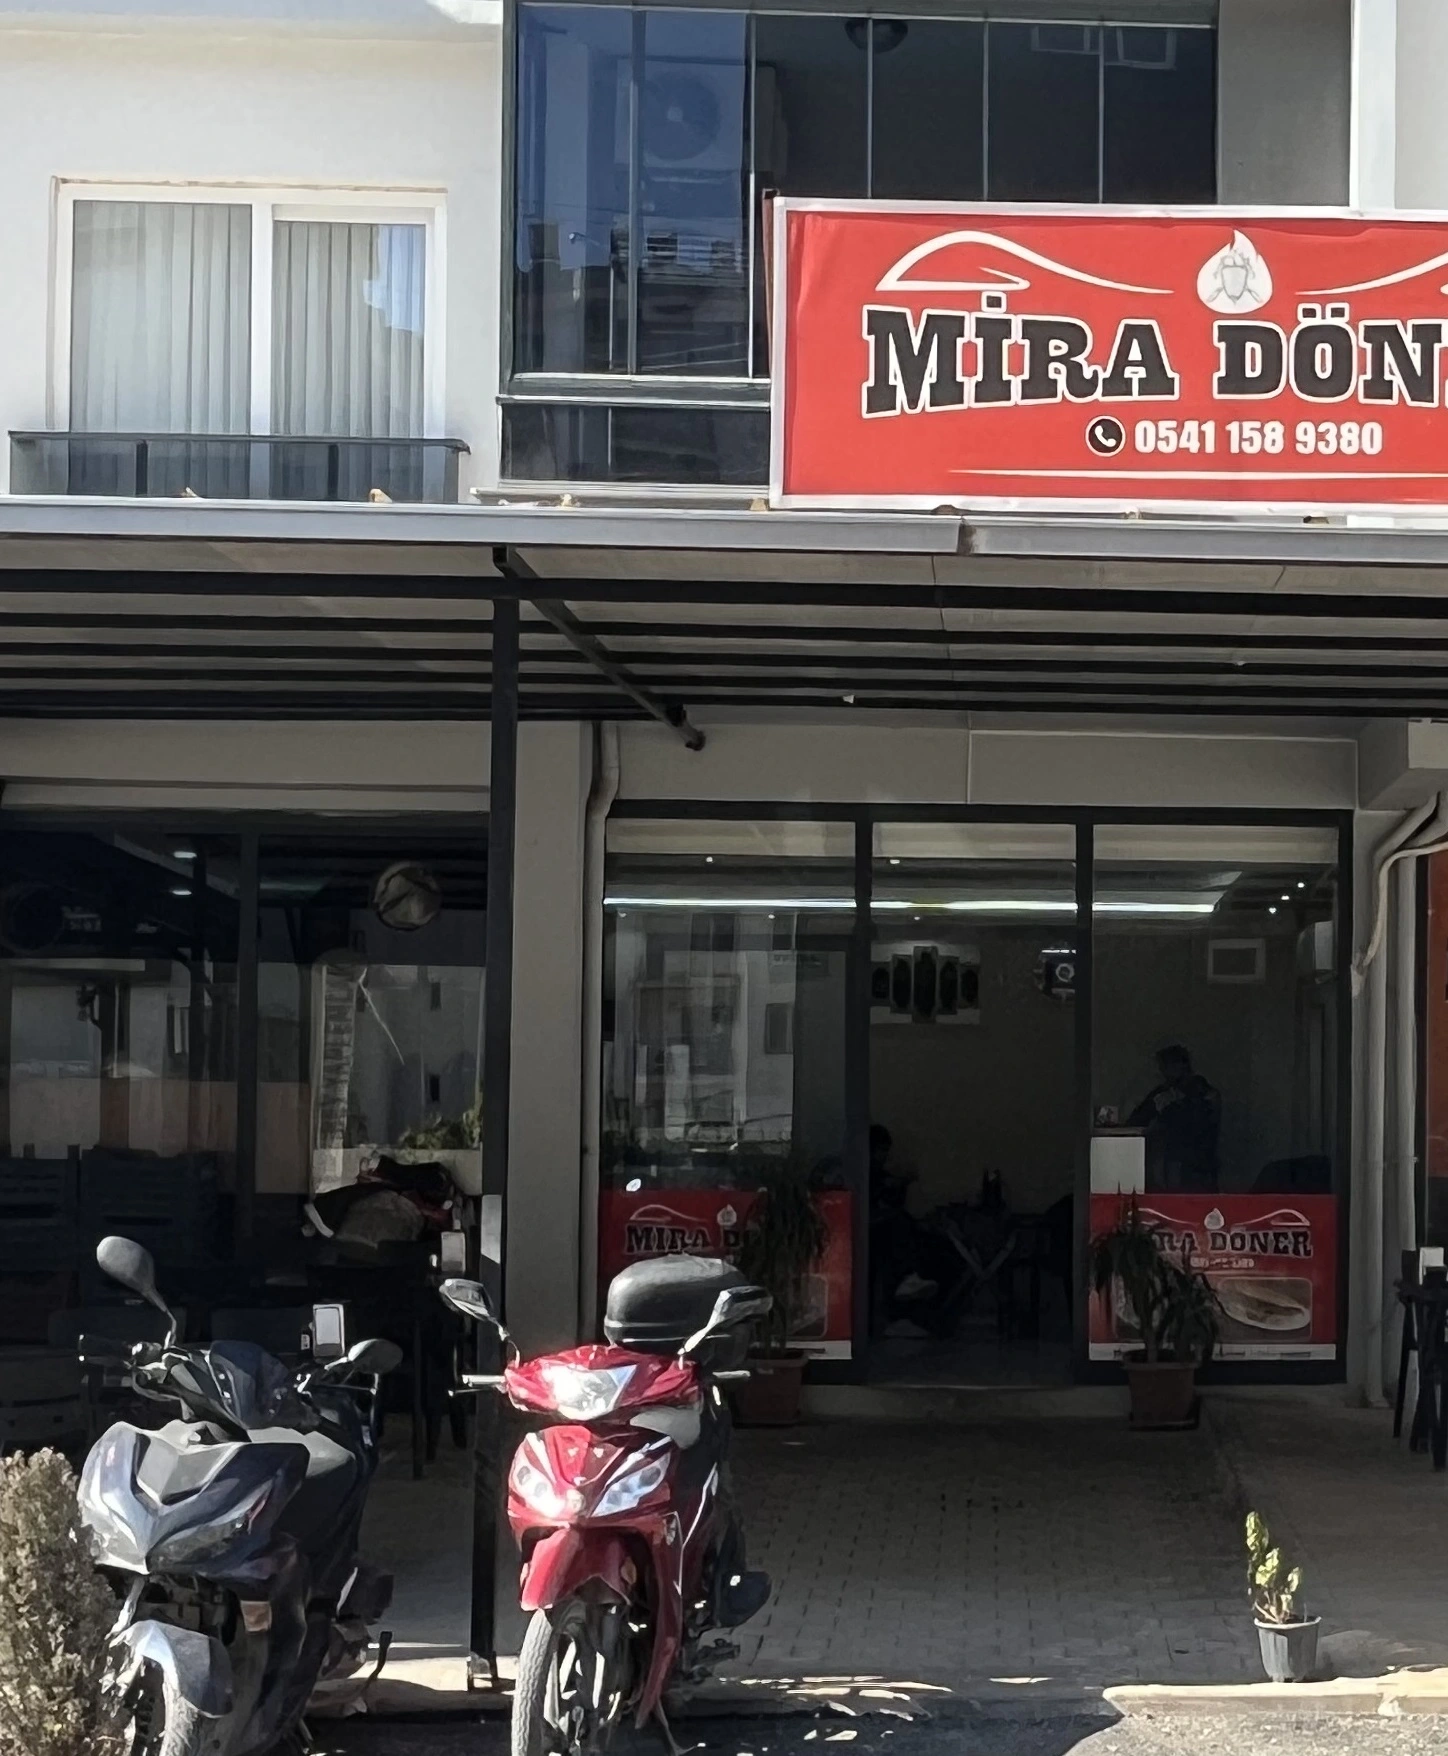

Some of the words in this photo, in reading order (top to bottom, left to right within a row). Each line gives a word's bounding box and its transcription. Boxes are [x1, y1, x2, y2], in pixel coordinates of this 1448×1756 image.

[862, 292, 1179, 419] MİRA
[1134, 420, 1216, 454] 0541
[1225, 421, 1285, 454] 158
[1295, 421, 1383, 455] 9380
